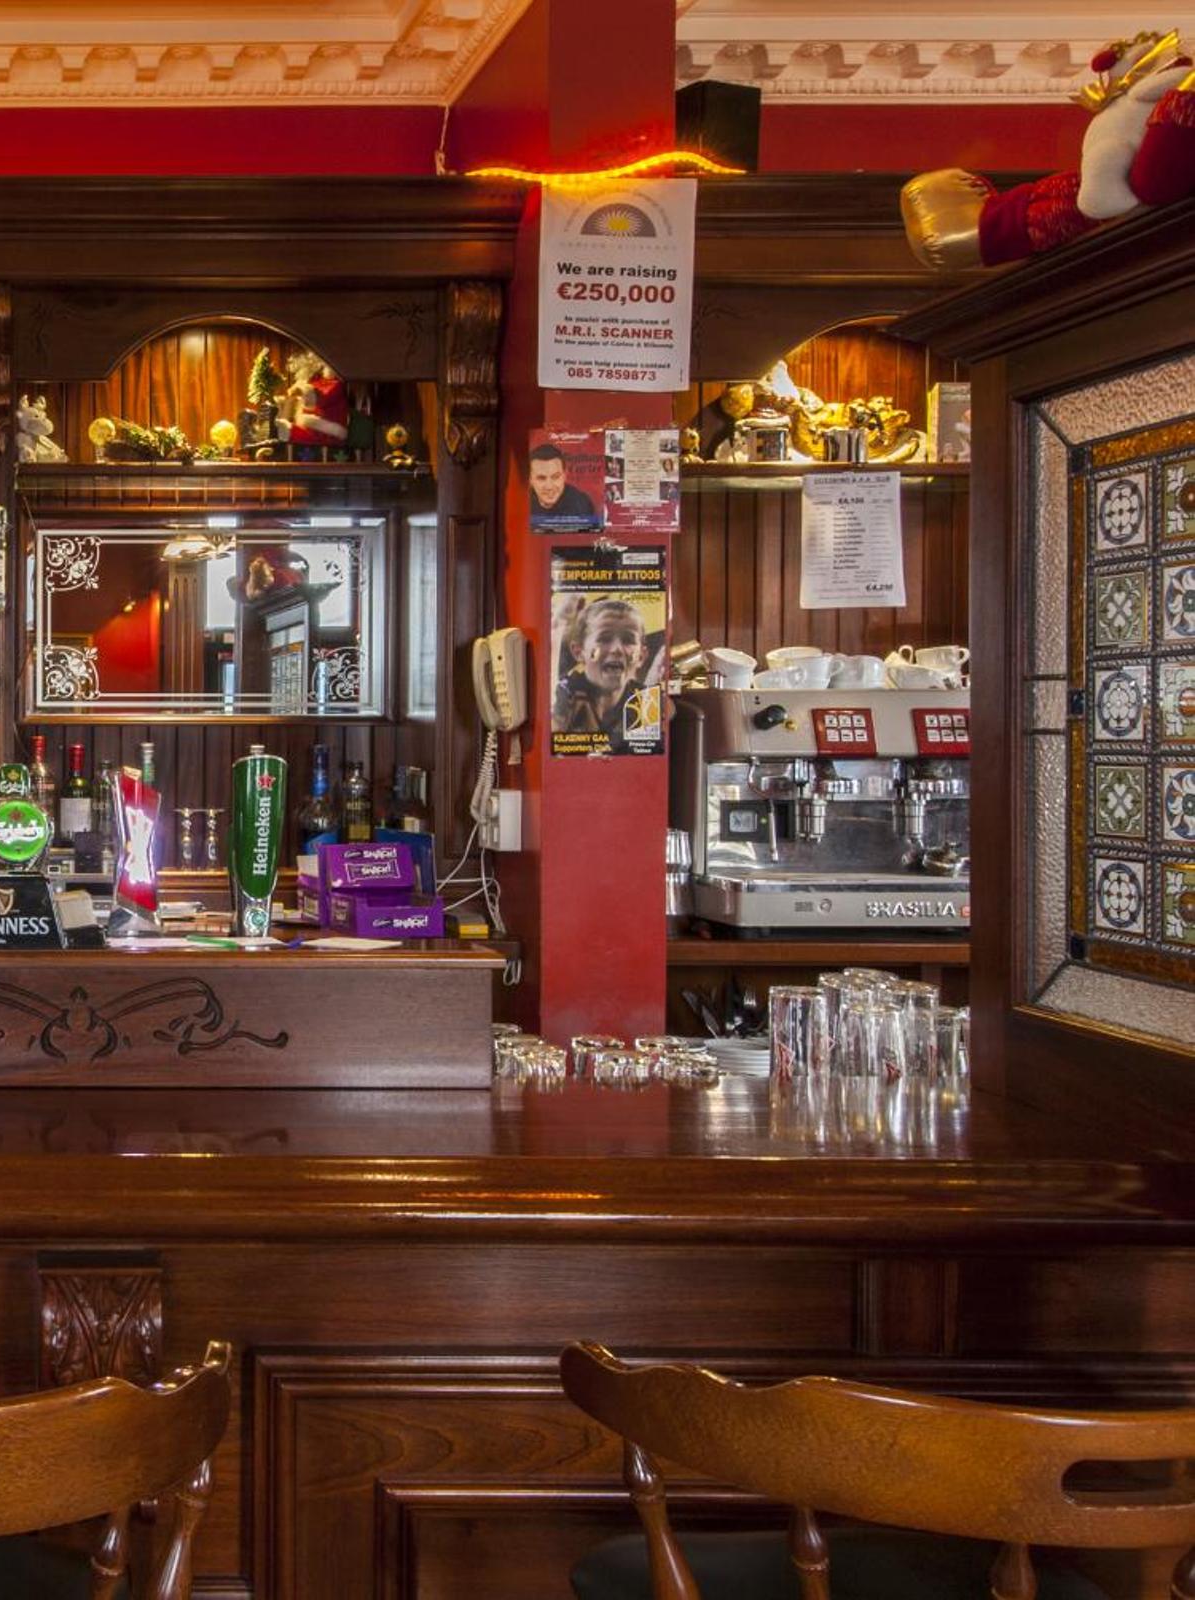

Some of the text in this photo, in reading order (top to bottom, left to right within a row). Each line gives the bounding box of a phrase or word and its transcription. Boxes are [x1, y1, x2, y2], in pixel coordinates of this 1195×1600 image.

[557, 262, 677, 281] We are raising
[557, 282, 675, 306] €250,000
[555, 325, 673, 340] M.R.I. SCANNER
[568, 367, 657, 381] 085 7859873
[552, 569, 661, 581] TEMPORARY TATTOOS
[252, 797, 272, 876] Heineken
[866, 901, 957, 918] BRASILIA
